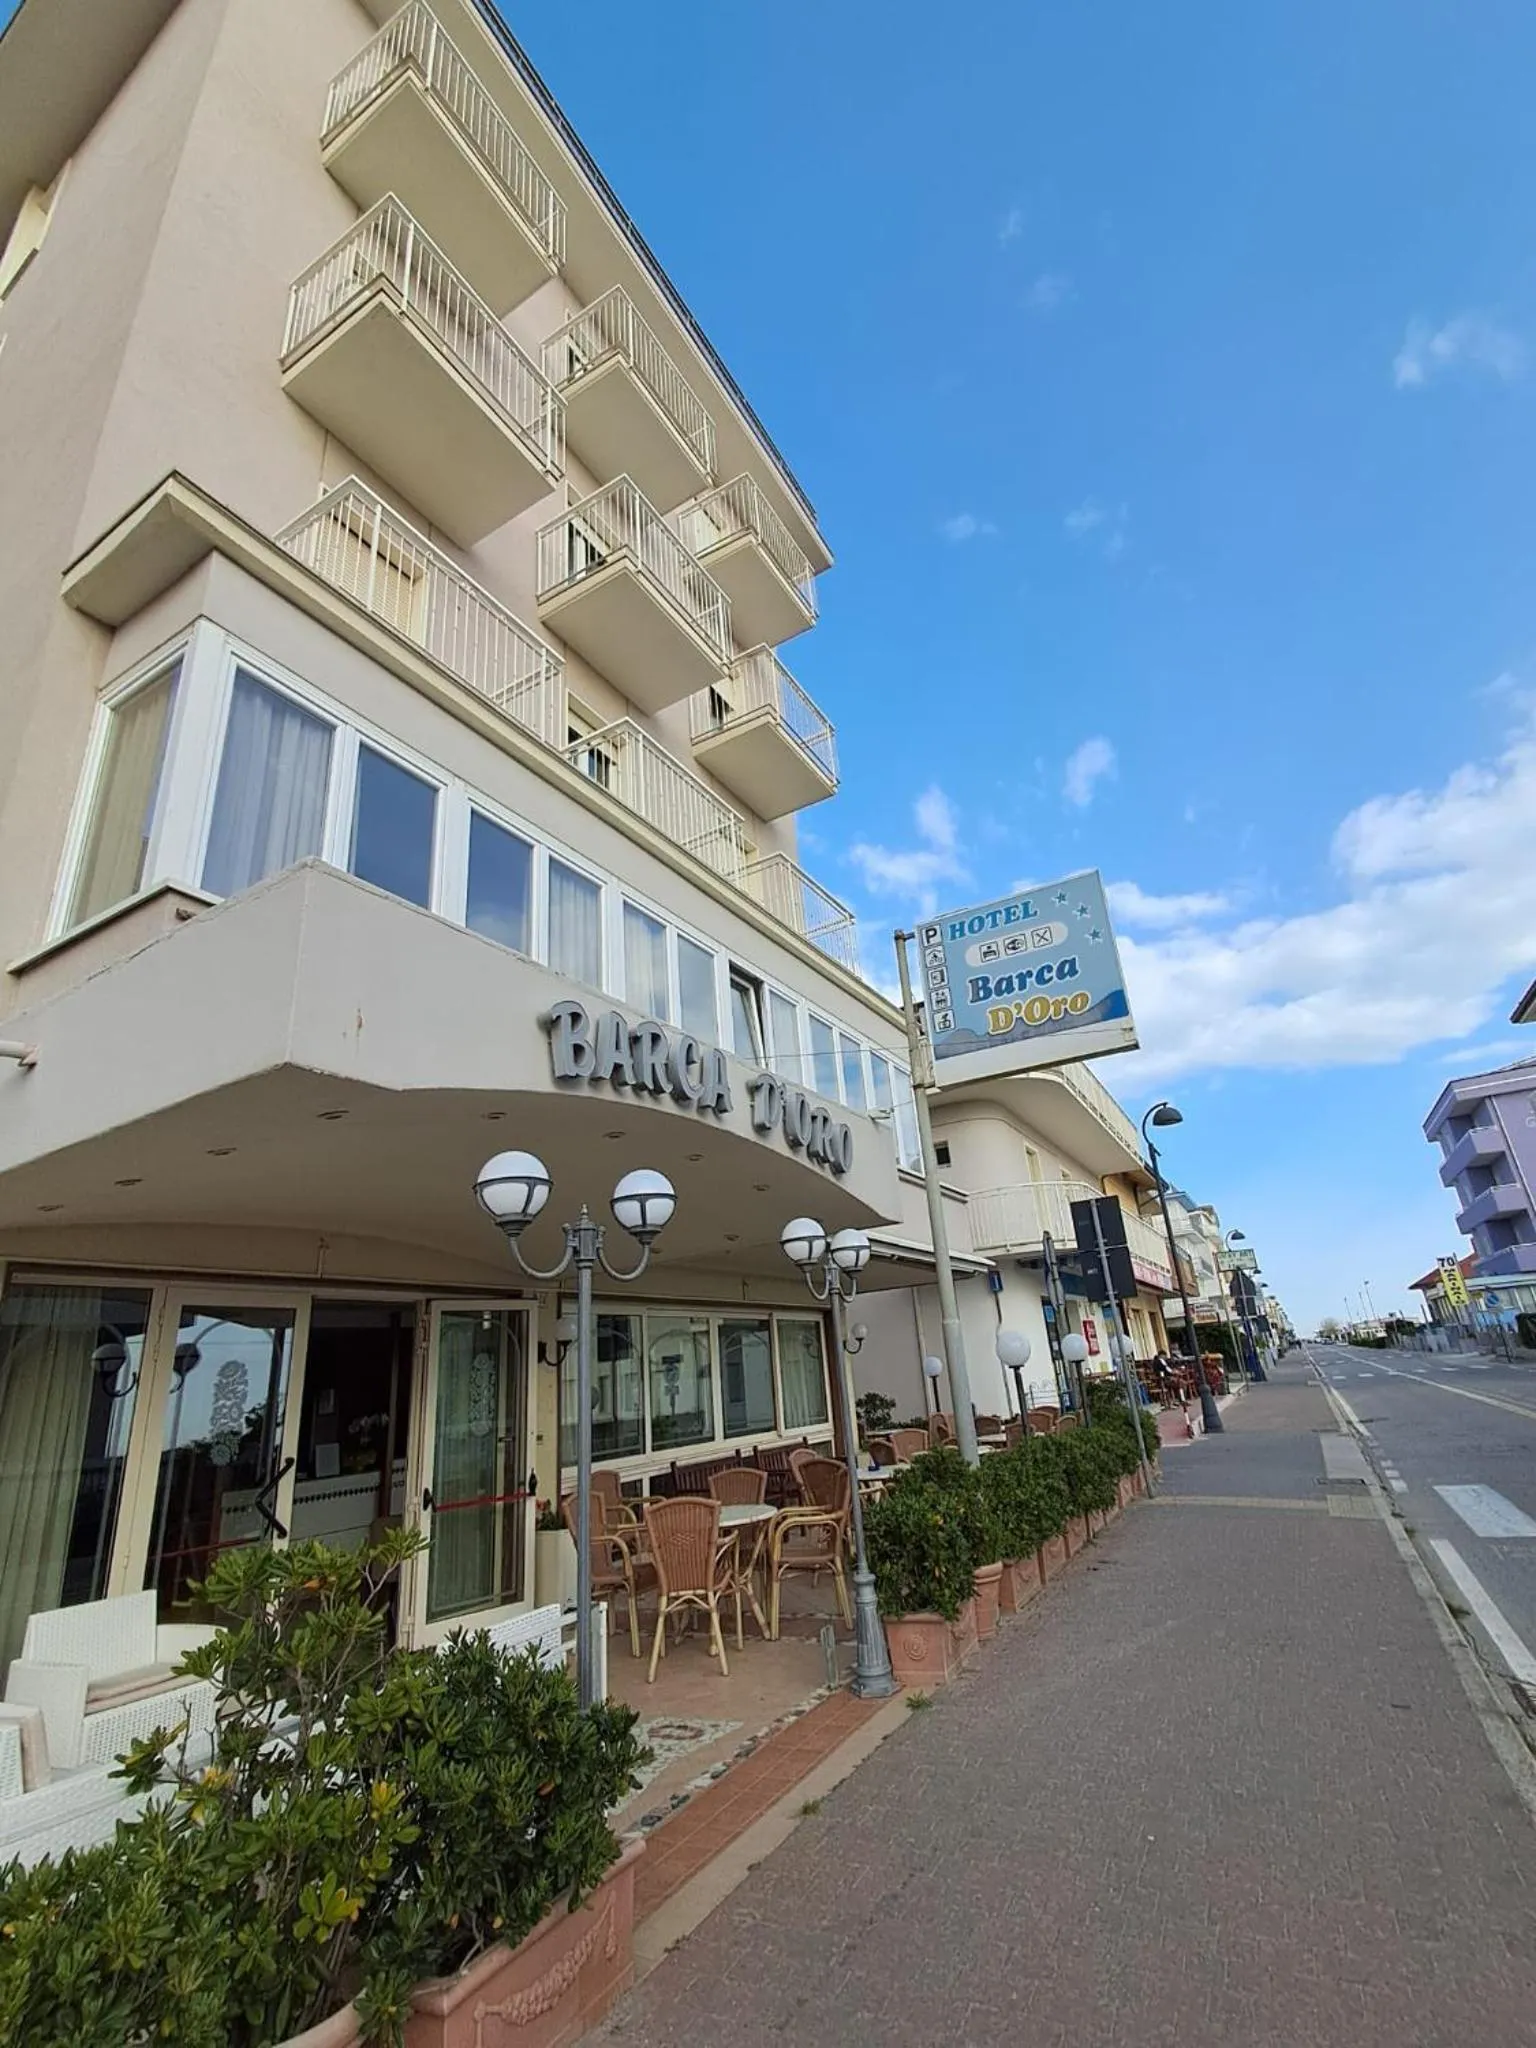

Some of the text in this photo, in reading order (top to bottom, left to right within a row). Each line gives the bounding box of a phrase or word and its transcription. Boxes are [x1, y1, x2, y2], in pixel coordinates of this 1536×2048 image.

[925, 928, 937, 945] P
[949, 900, 1039, 941] HOTEL
[968, 955, 1080, 1004] Barca
[988, 992, 1091, 1035] D'Oro
[550, 1000, 734, 1117] BARCA
[751, 1073, 853, 1174] D'ORO
